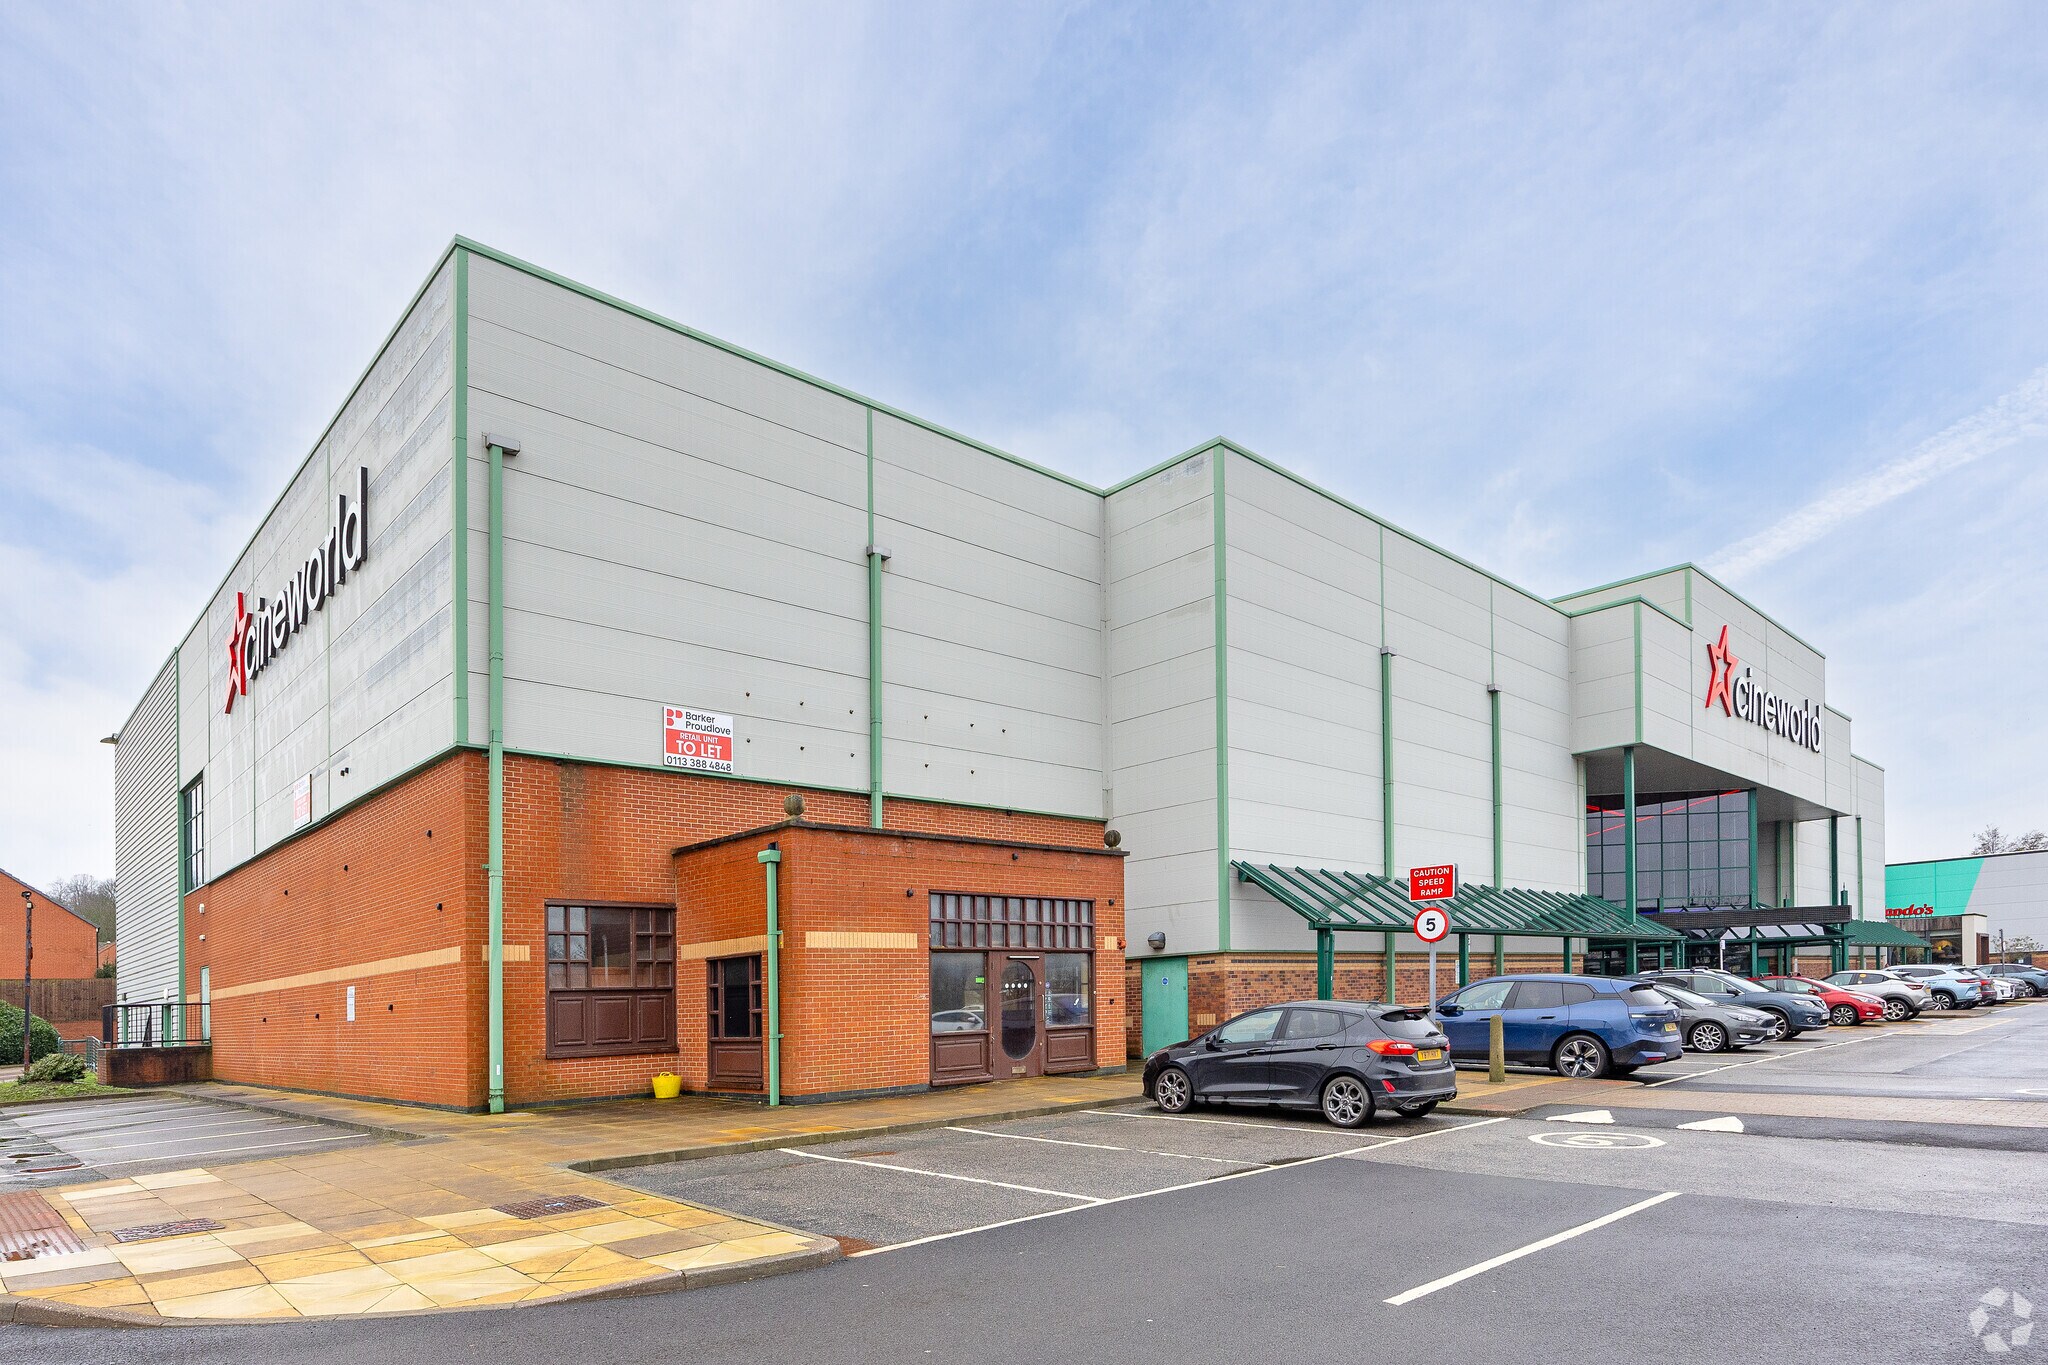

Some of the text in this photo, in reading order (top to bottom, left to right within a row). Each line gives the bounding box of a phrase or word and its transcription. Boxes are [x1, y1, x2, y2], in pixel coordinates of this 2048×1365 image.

[244, 466, 368, 680] cineworld
[1733, 667, 1821, 753] cineworld
[685, 712, 715, 724] Barker
[685, 721, 731, 735] Proudlove
[680, 732, 701, 742] RETAIL
[676, 740, 722, 758] TO LET
[667, 755, 731, 771] 0113 388 4848
[1413, 867, 1449, 877] CAUTION
[1418, 878, 1444, 886] SPEED
[1420, 888, 1443, 896] RAMP
[1885, 904, 1933, 916] ando's
[1426, 918, 1436, 931] 5
